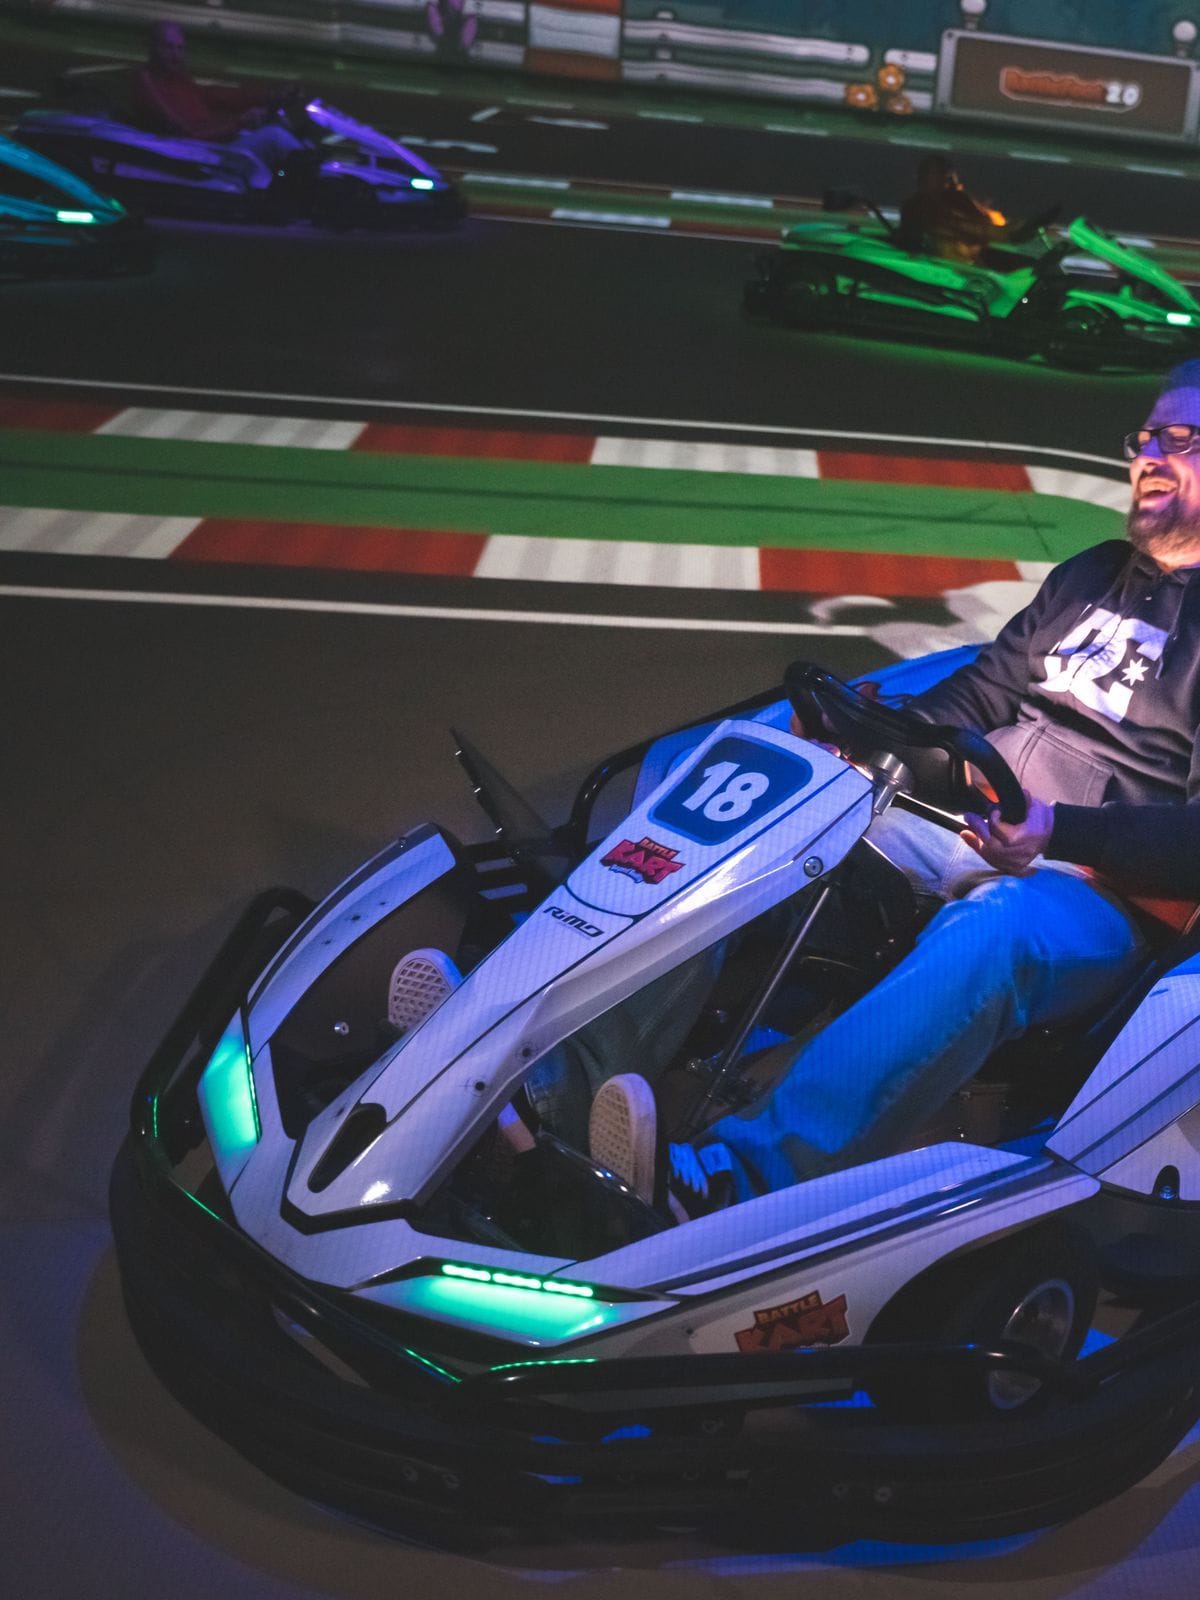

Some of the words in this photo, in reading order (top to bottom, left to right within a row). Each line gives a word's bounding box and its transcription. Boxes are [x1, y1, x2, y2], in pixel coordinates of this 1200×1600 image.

[682, 761, 770, 822] 18
[600, 839, 686, 885] KART
[638, 837, 680, 860] BATTLE
[756, 1292, 819, 1324] BATTLE
